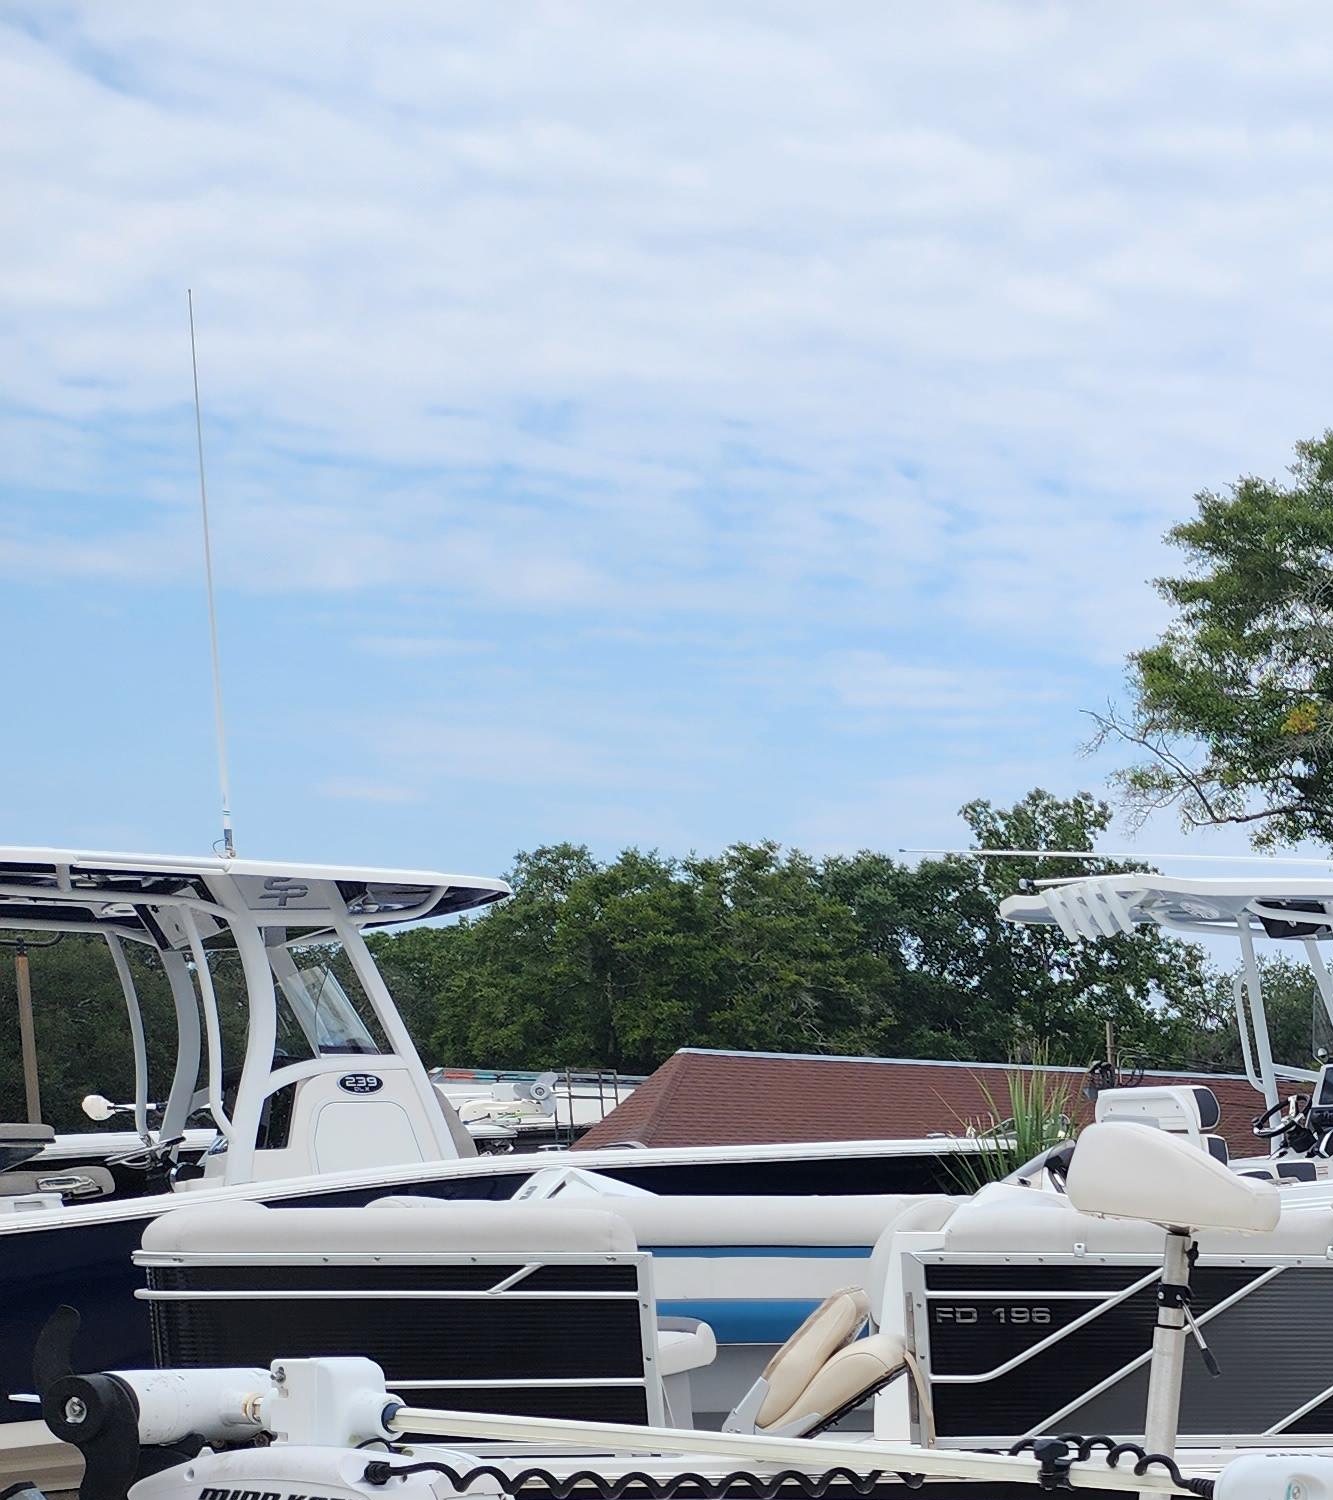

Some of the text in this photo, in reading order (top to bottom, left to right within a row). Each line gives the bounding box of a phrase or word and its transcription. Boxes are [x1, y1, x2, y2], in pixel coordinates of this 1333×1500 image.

[345, 1076, 378, 1087] 239
[935, 1307, 1052, 1324] FD 196
